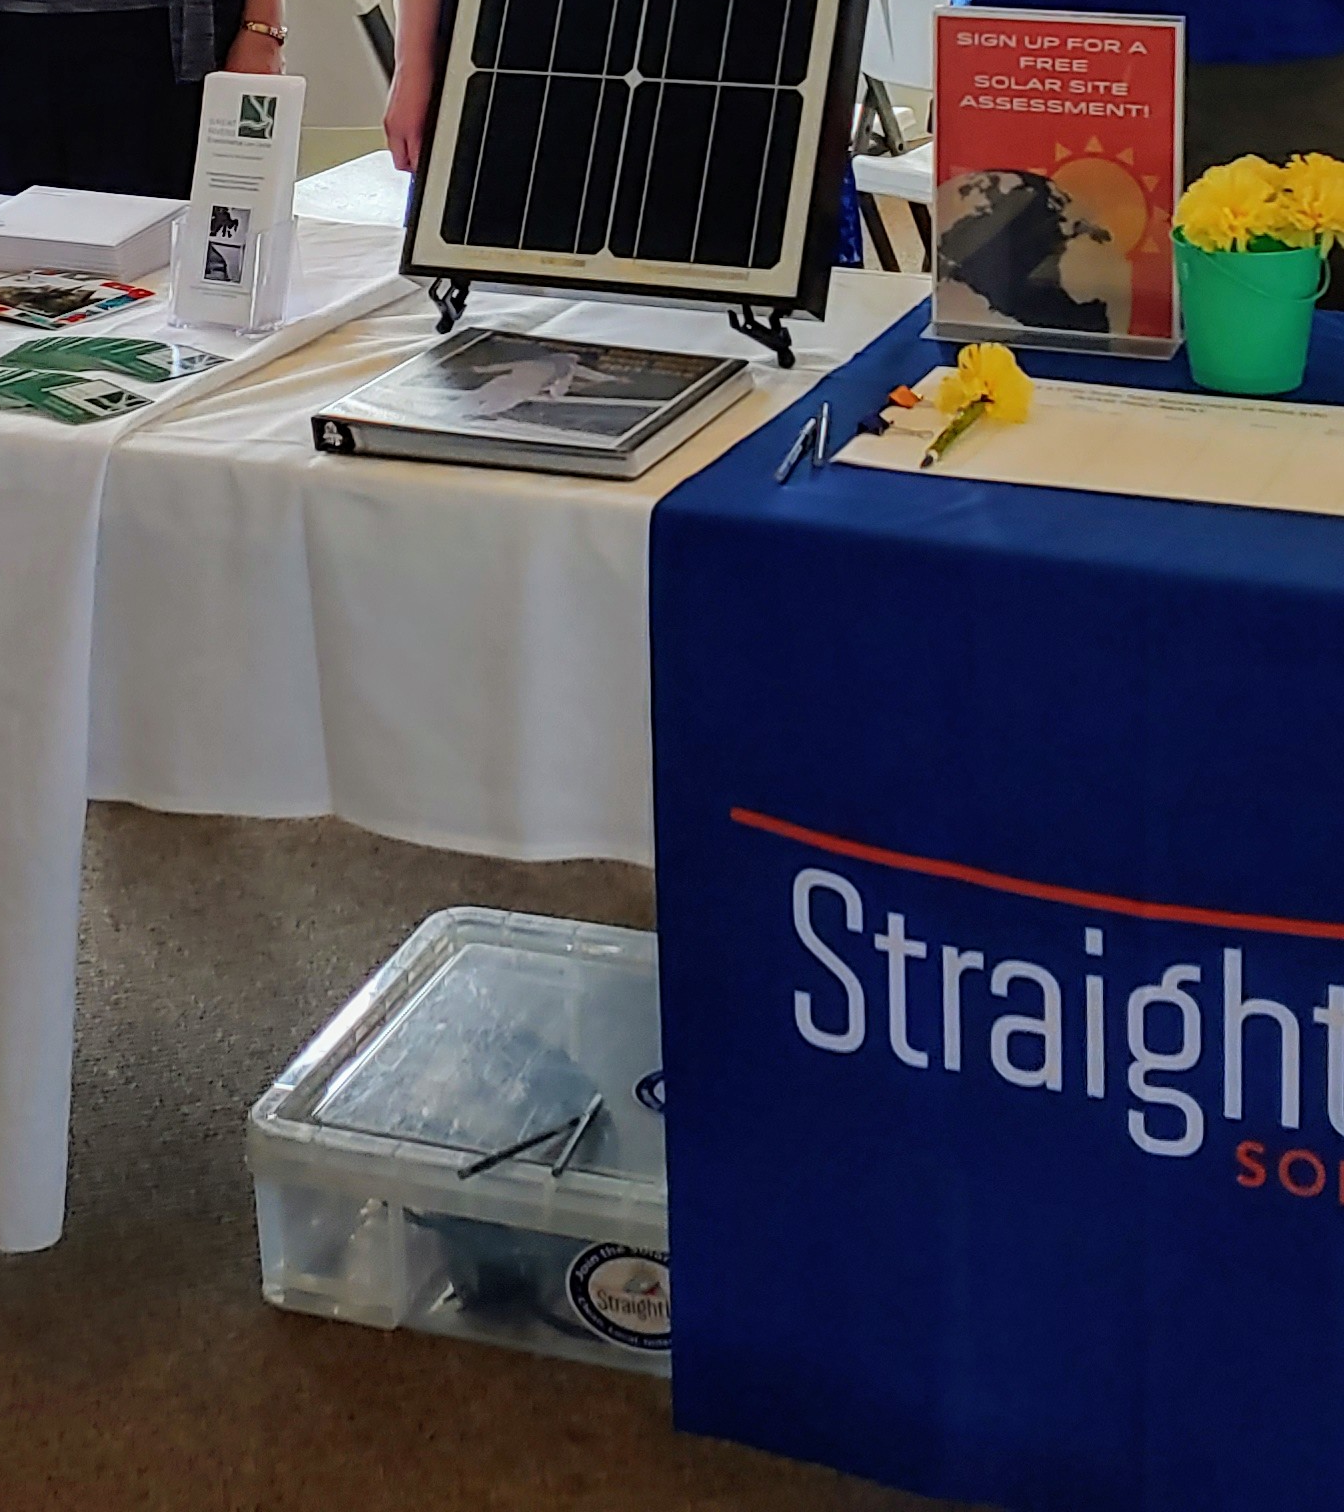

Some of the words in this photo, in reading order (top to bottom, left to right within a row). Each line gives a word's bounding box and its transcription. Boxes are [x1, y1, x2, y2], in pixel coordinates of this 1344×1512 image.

[956, 31, 1017, 49] SIGN
[1023, 35, 1060, 52] UP
[1066, 37, 1121, 55] FOR
[1128, 40, 1149, 55] A
[1019, 56, 1089, 73] FREE
[974, 74, 1062, 93] SOLAR
[1068, 78, 1130, 96] SITE
[959, 95, 1150, 118] ASSESSMENT!
[599, 1244, 626, 1259] the
